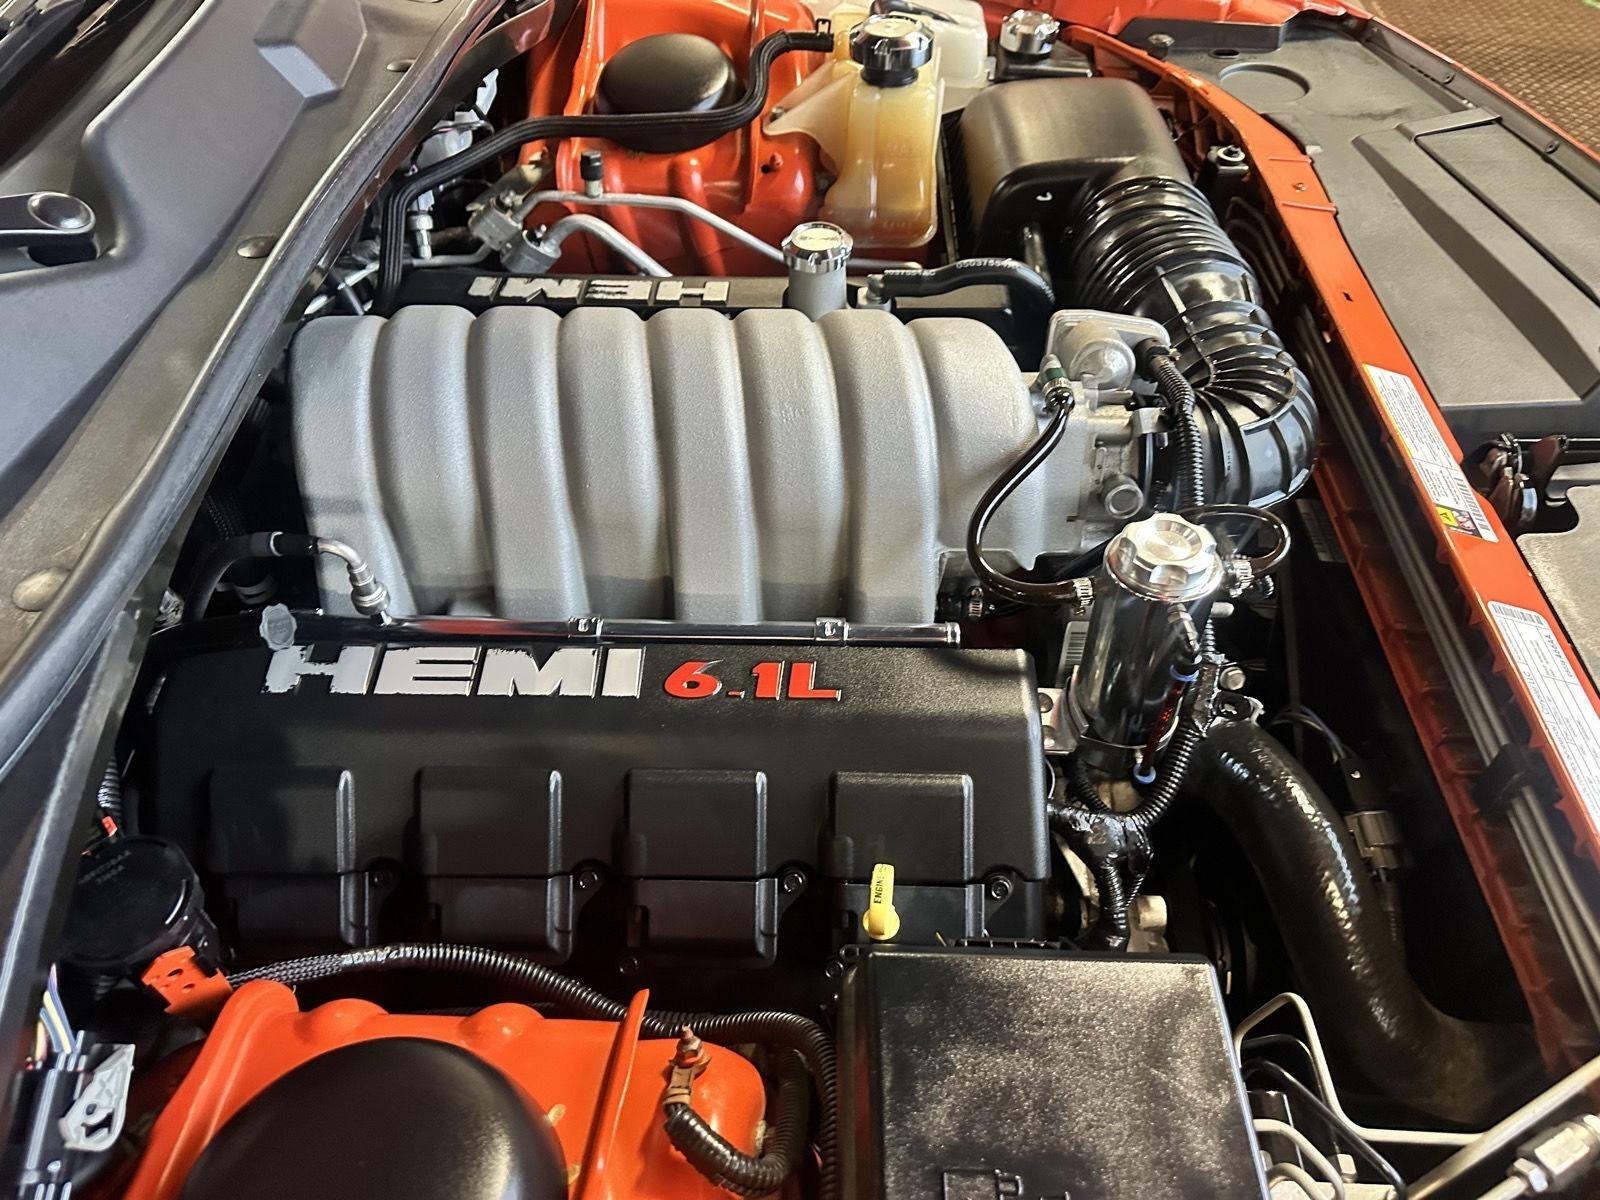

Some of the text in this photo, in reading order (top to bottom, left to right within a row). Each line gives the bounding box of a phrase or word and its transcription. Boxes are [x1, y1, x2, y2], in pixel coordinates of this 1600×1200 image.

[468, 276, 730, 302] HEMI
[260, 645, 842, 702] HEMI 6.1L
